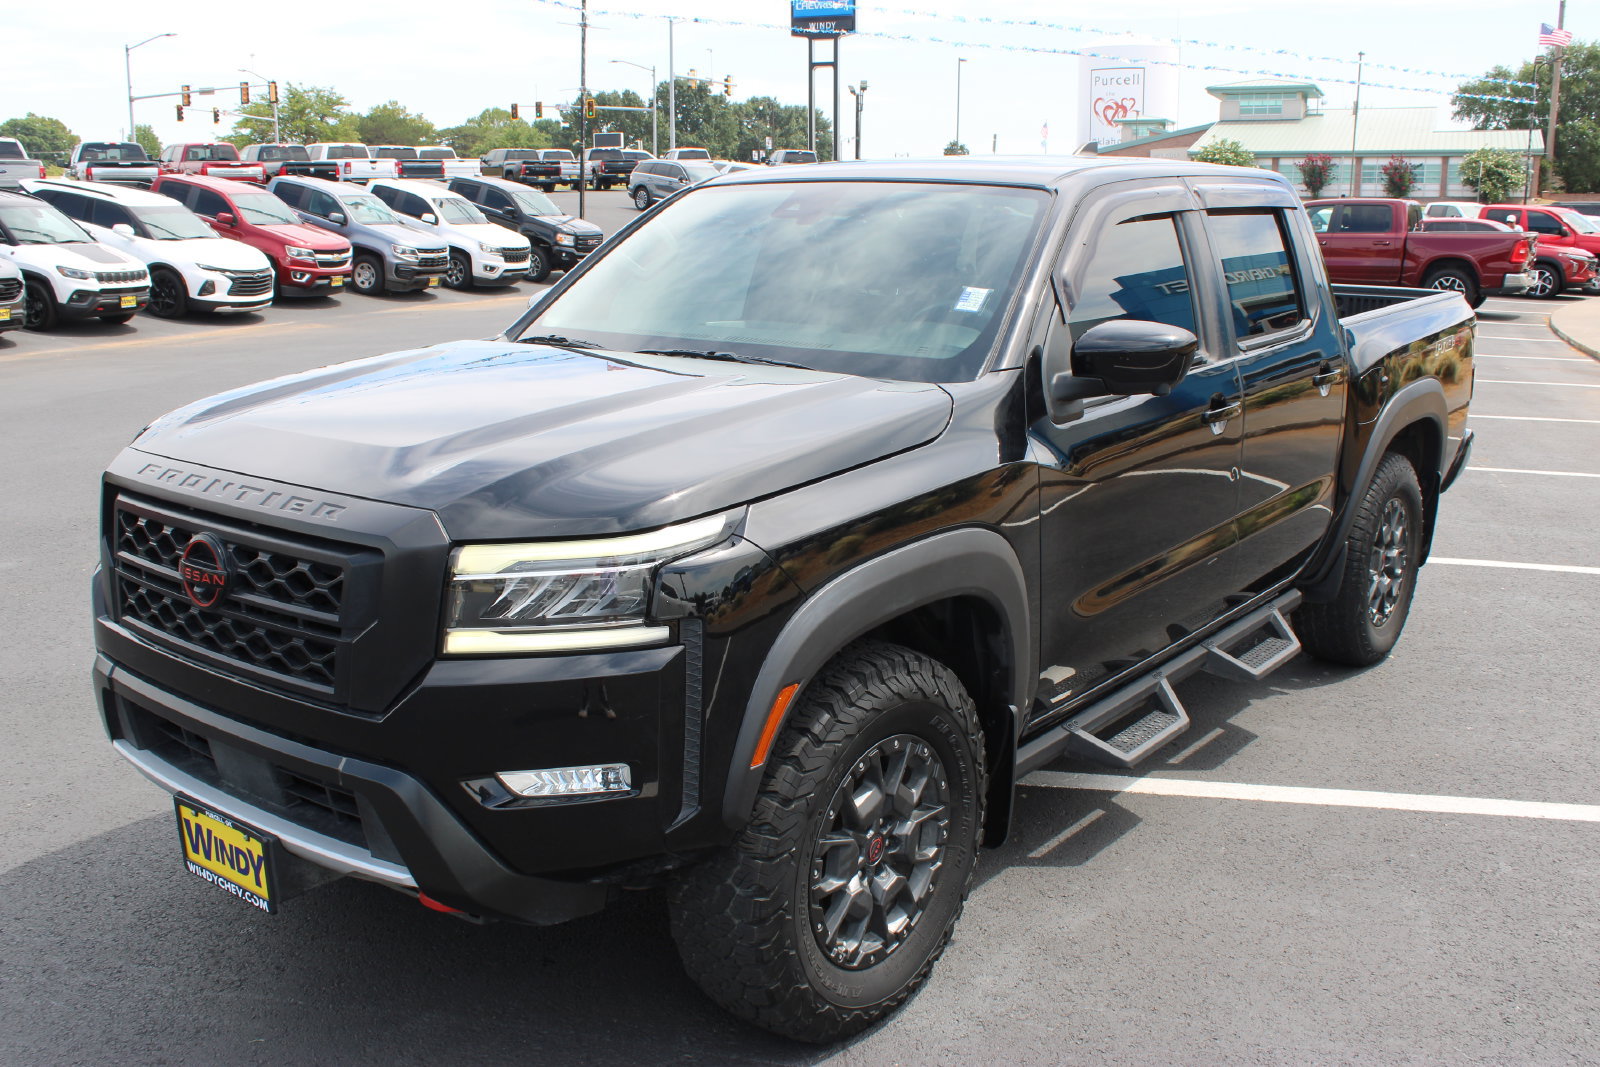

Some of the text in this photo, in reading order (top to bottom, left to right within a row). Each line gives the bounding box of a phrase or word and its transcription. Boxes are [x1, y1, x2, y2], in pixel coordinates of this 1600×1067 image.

[809, 22, 836, 30] WINDY
[1094, 74, 1140, 86] Purcell
[137, 463, 348, 521] FRONTIER
[184, 818, 264, 888] WINDY
[187, 860, 270, 913] WINDYCHEV.COM
